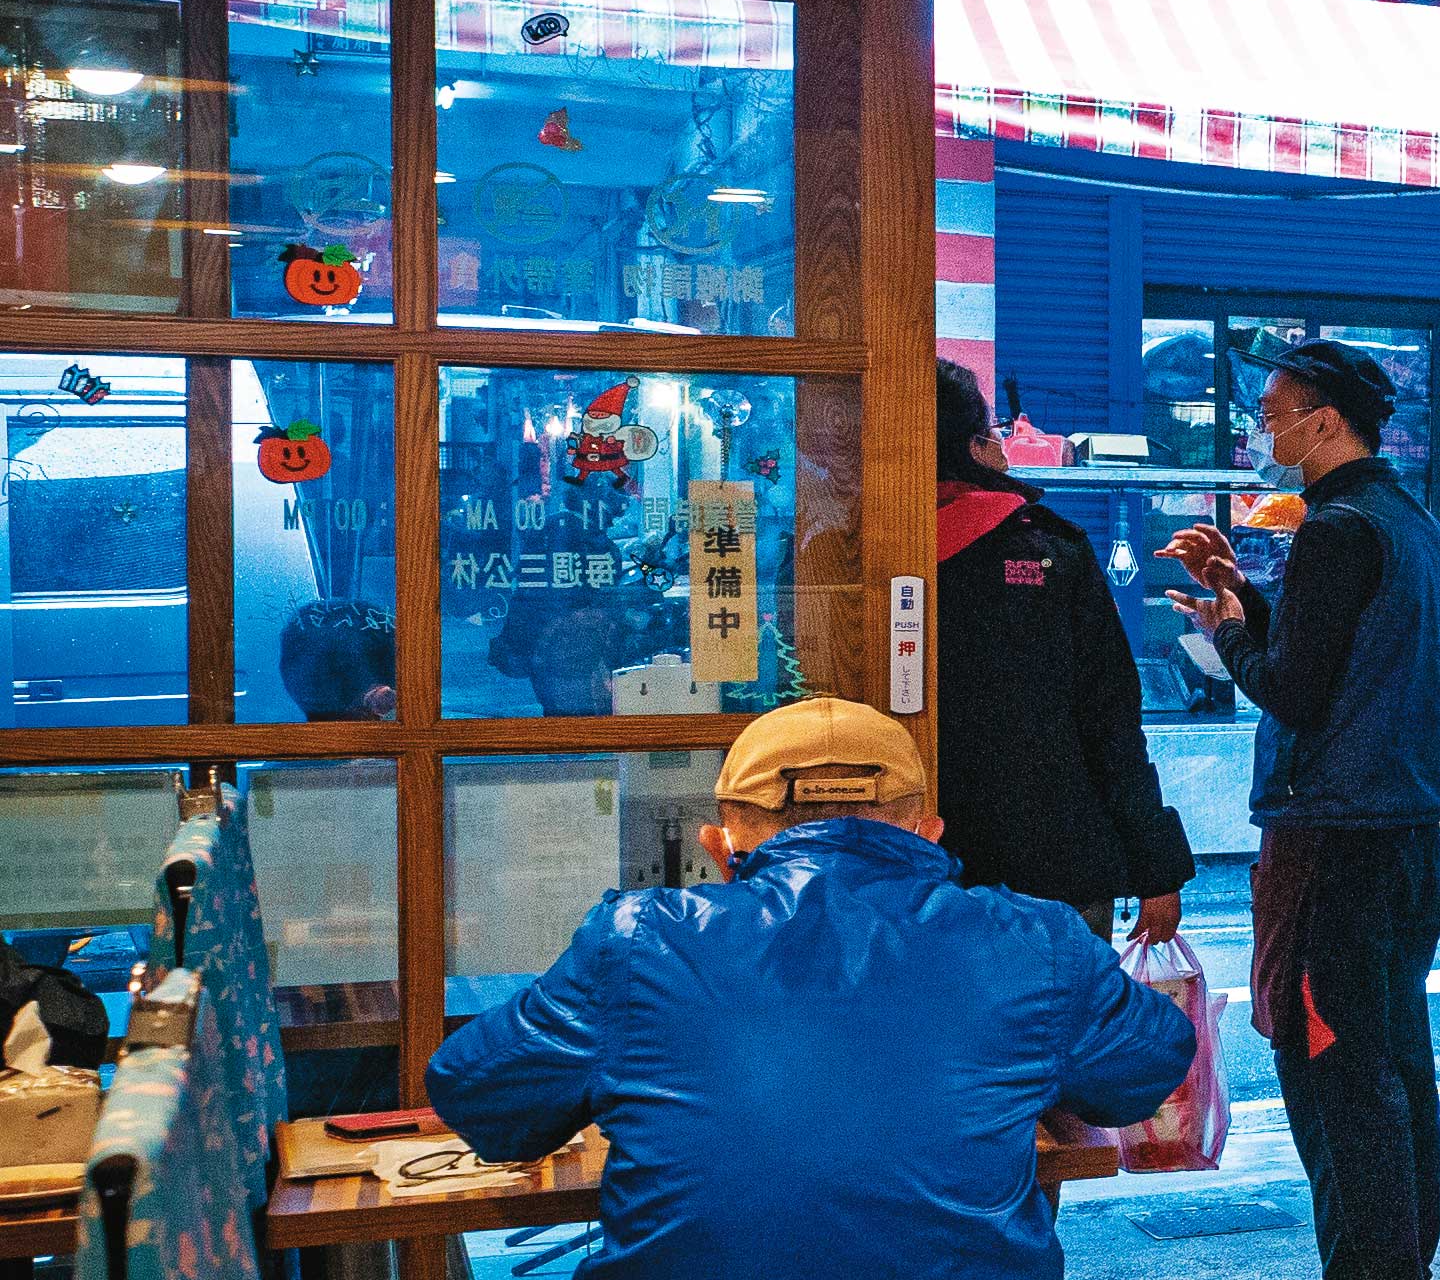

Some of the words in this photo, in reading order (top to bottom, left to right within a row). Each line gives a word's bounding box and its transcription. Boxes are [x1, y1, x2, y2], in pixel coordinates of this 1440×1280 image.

[702, 526, 742, 639] 準備中
[900, 584, 915, 611] 自動
[894, 621, 920, 629] PUSH
[897, 640, 916, 658] 押
